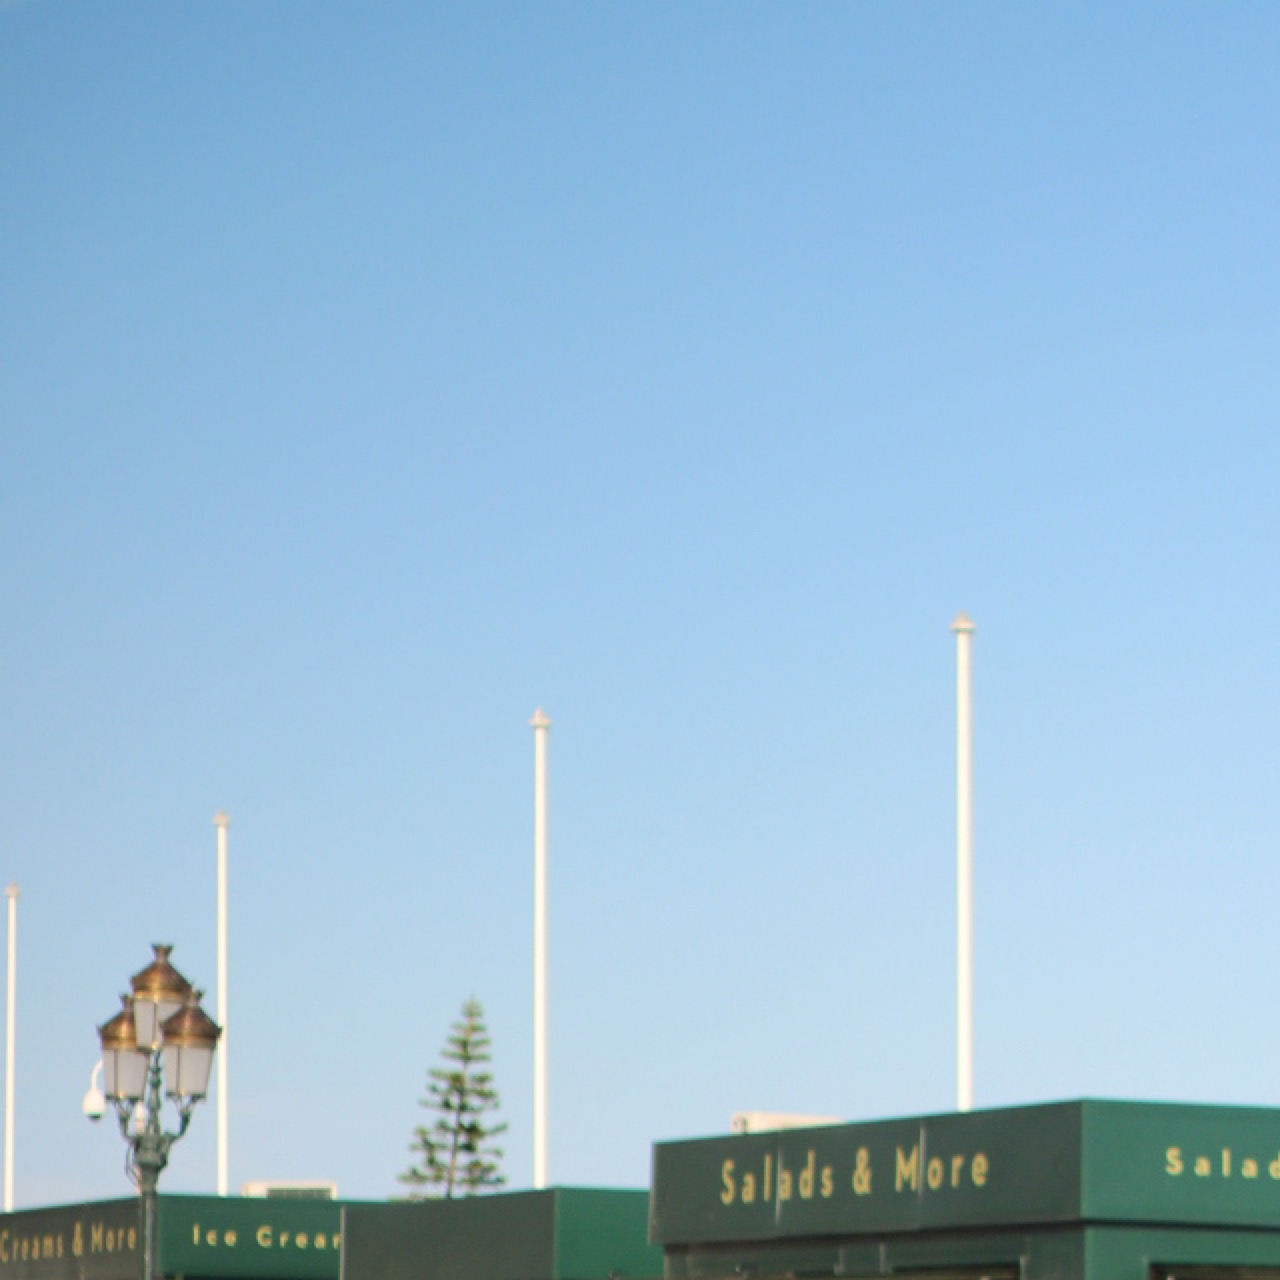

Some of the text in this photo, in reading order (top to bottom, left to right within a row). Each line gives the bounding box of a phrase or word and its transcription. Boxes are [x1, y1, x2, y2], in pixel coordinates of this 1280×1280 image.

[720, 1145, 989, 1205] Salads & More
[72, 1221, 83, 1256] &
[91, 1222, 136, 1254] More
[193, 1223, 237, 1247] Ice
